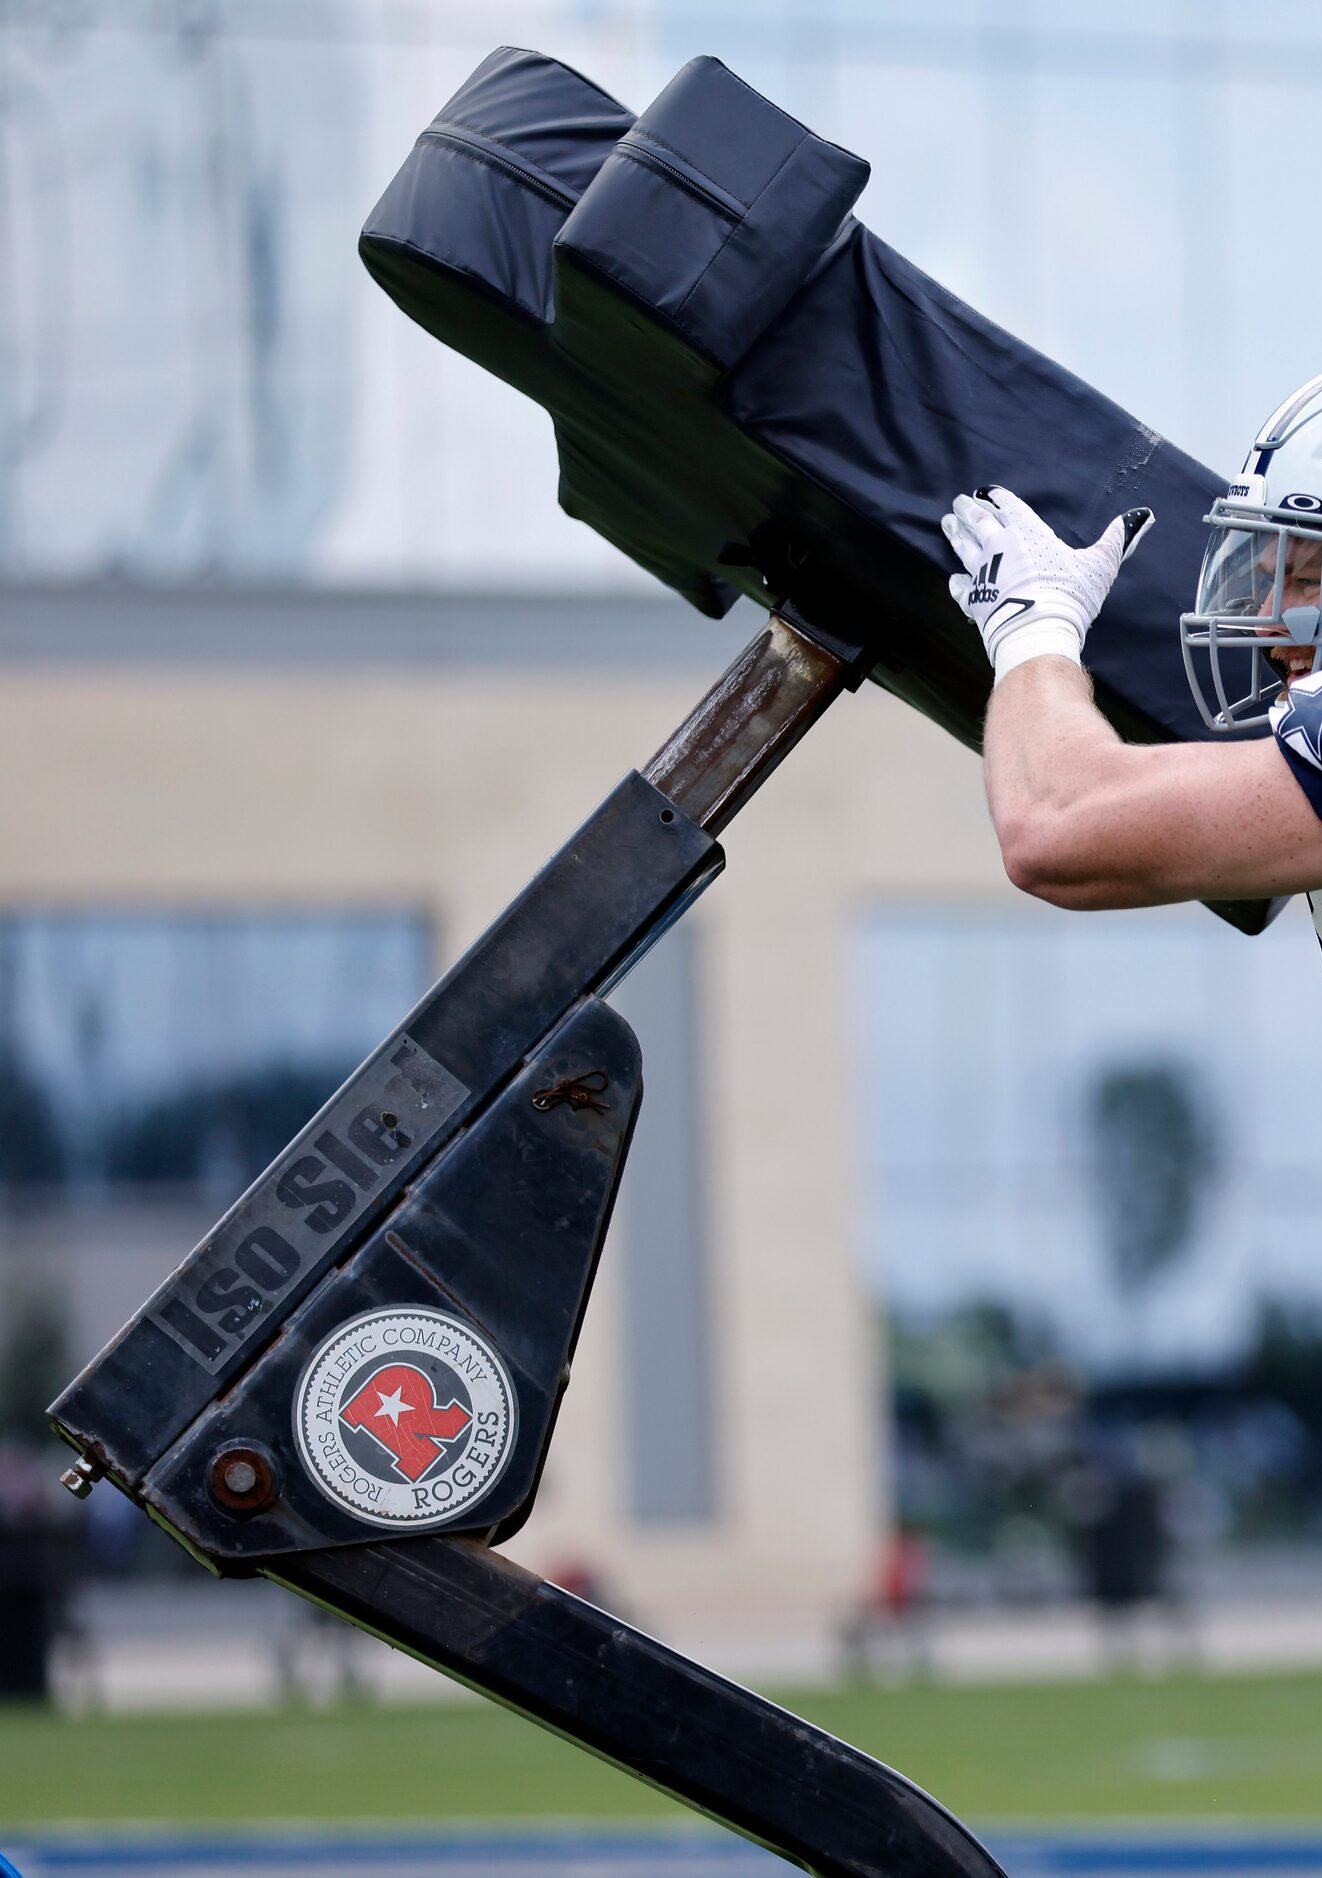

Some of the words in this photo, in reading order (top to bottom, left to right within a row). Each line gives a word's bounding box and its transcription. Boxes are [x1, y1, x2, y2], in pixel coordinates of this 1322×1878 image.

[159, 1226, 301, 1362] Iso
[315, 1335, 378, 1425] ATHLETIC
[382, 1327, 488, 1383] COMPANY
[318, 1431, 384, 1503] ROGERS
[411, 1411, 499, 1510] ROGERS
